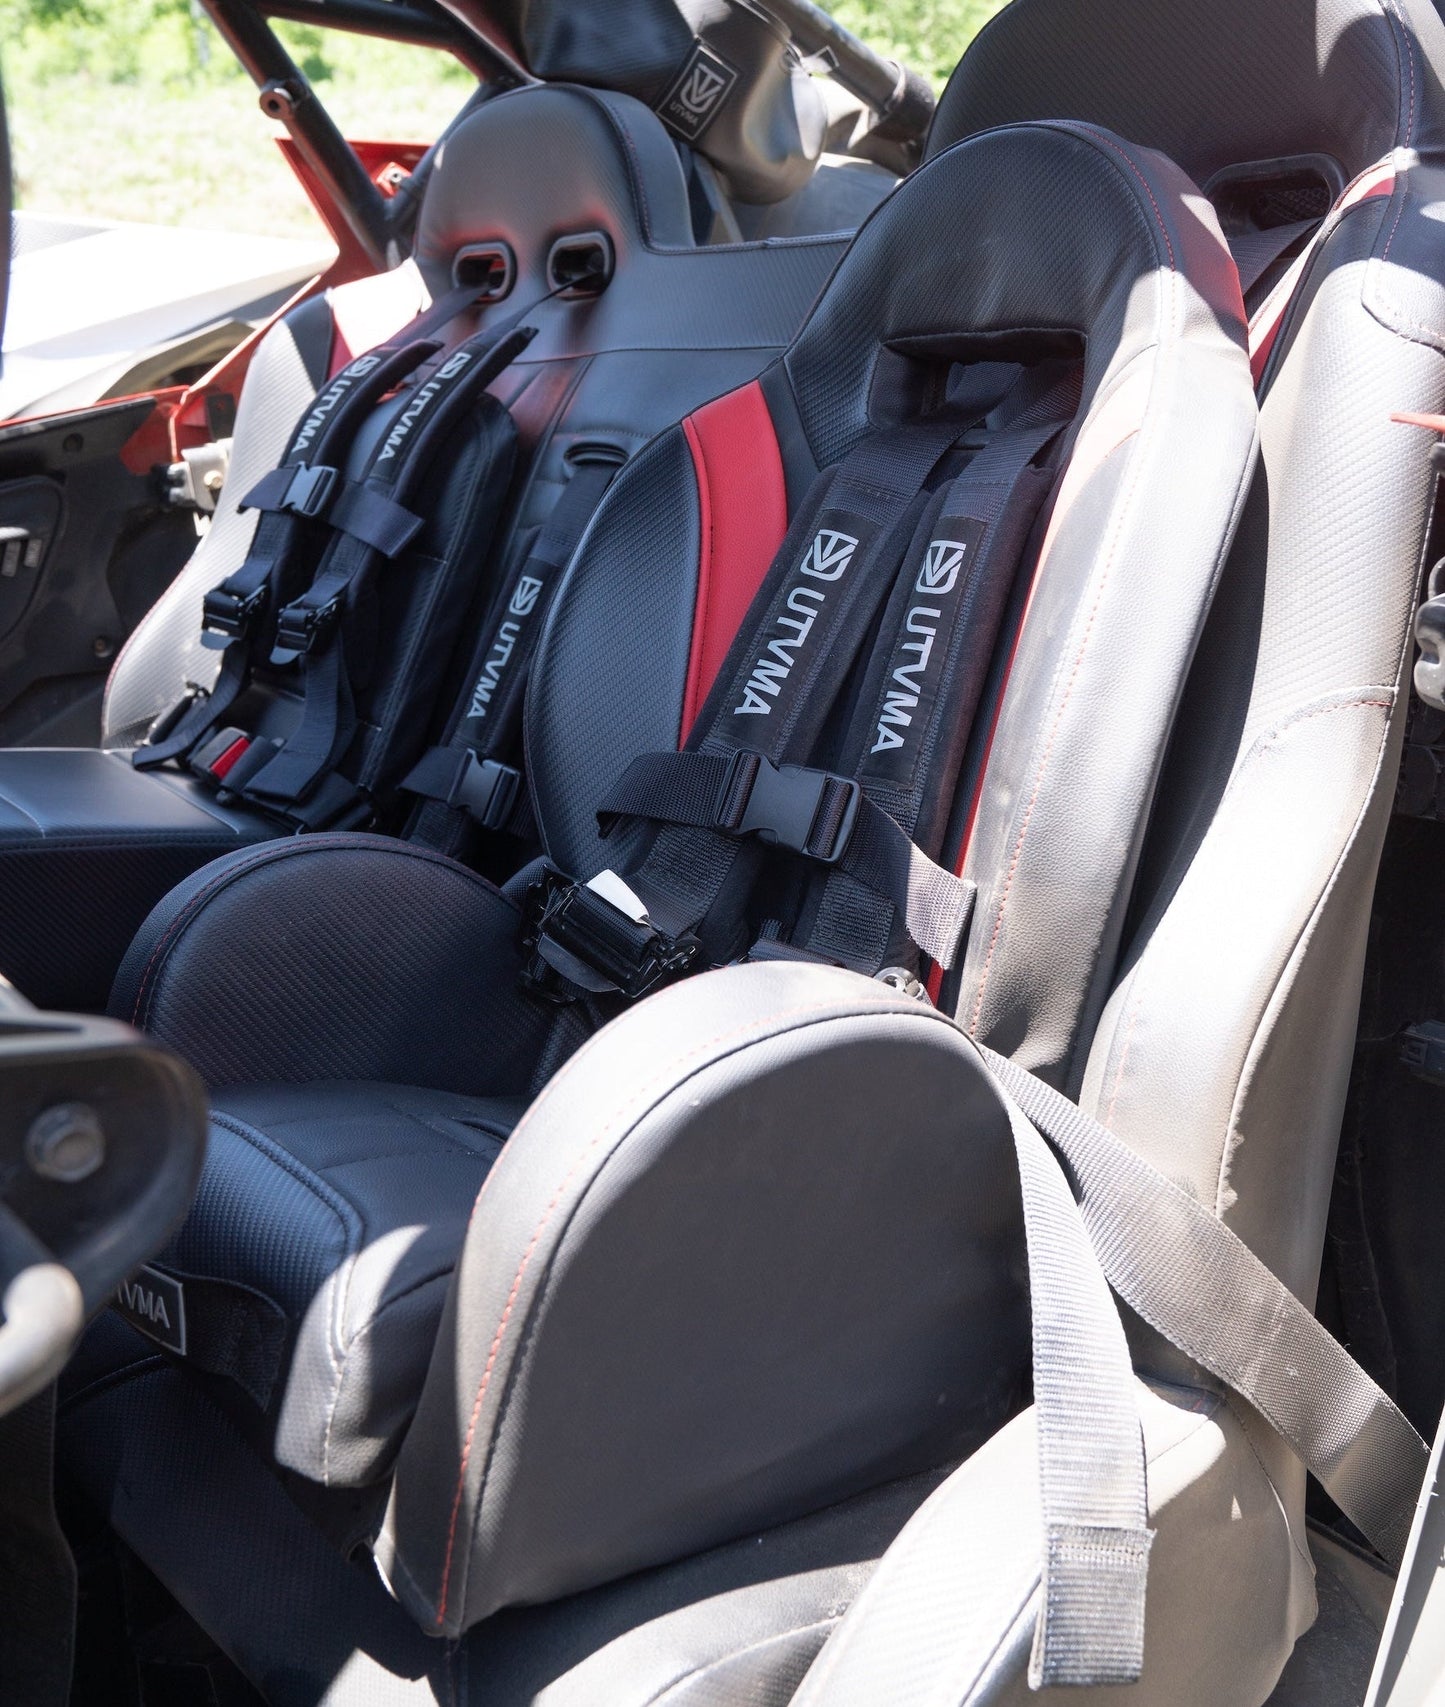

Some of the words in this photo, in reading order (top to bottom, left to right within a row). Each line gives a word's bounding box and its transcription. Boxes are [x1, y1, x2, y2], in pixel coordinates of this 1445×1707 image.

[292, 380, 352, 452] UTVMA
[378, 382, 441, 461] UTVMA
[467, 621, 520, 718] UTVMA
[734, 587, 825, 714] UTVMA
[871, 606, 941, 753] UTVMA
